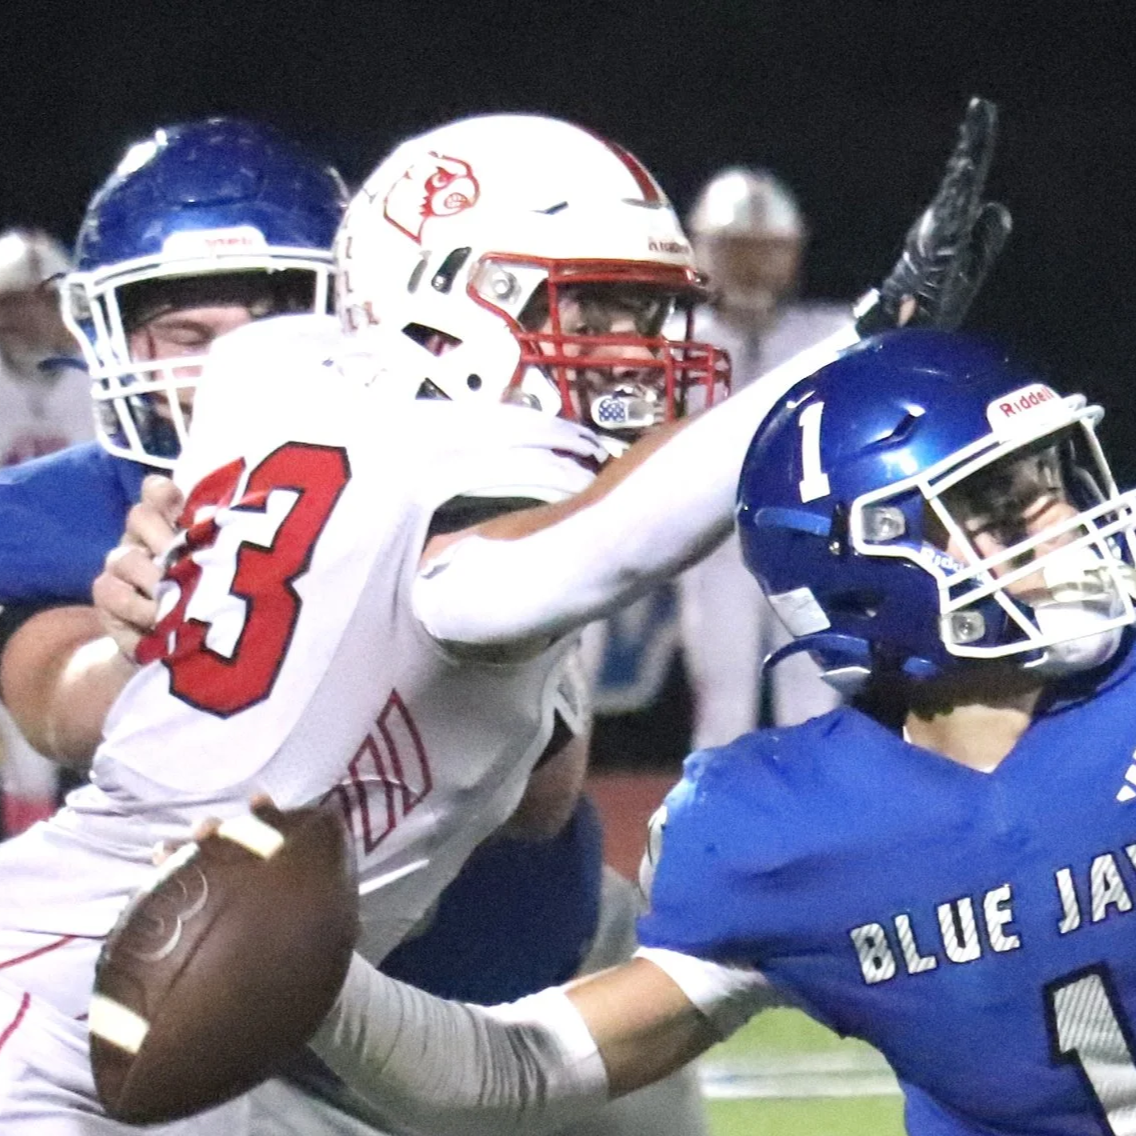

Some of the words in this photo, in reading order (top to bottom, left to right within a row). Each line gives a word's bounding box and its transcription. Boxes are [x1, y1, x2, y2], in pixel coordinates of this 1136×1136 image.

[798, 400, 831, 504] 1
[998, 385, 1056, 418] Riddell
[849, 882, 1021, 985] BLUE
